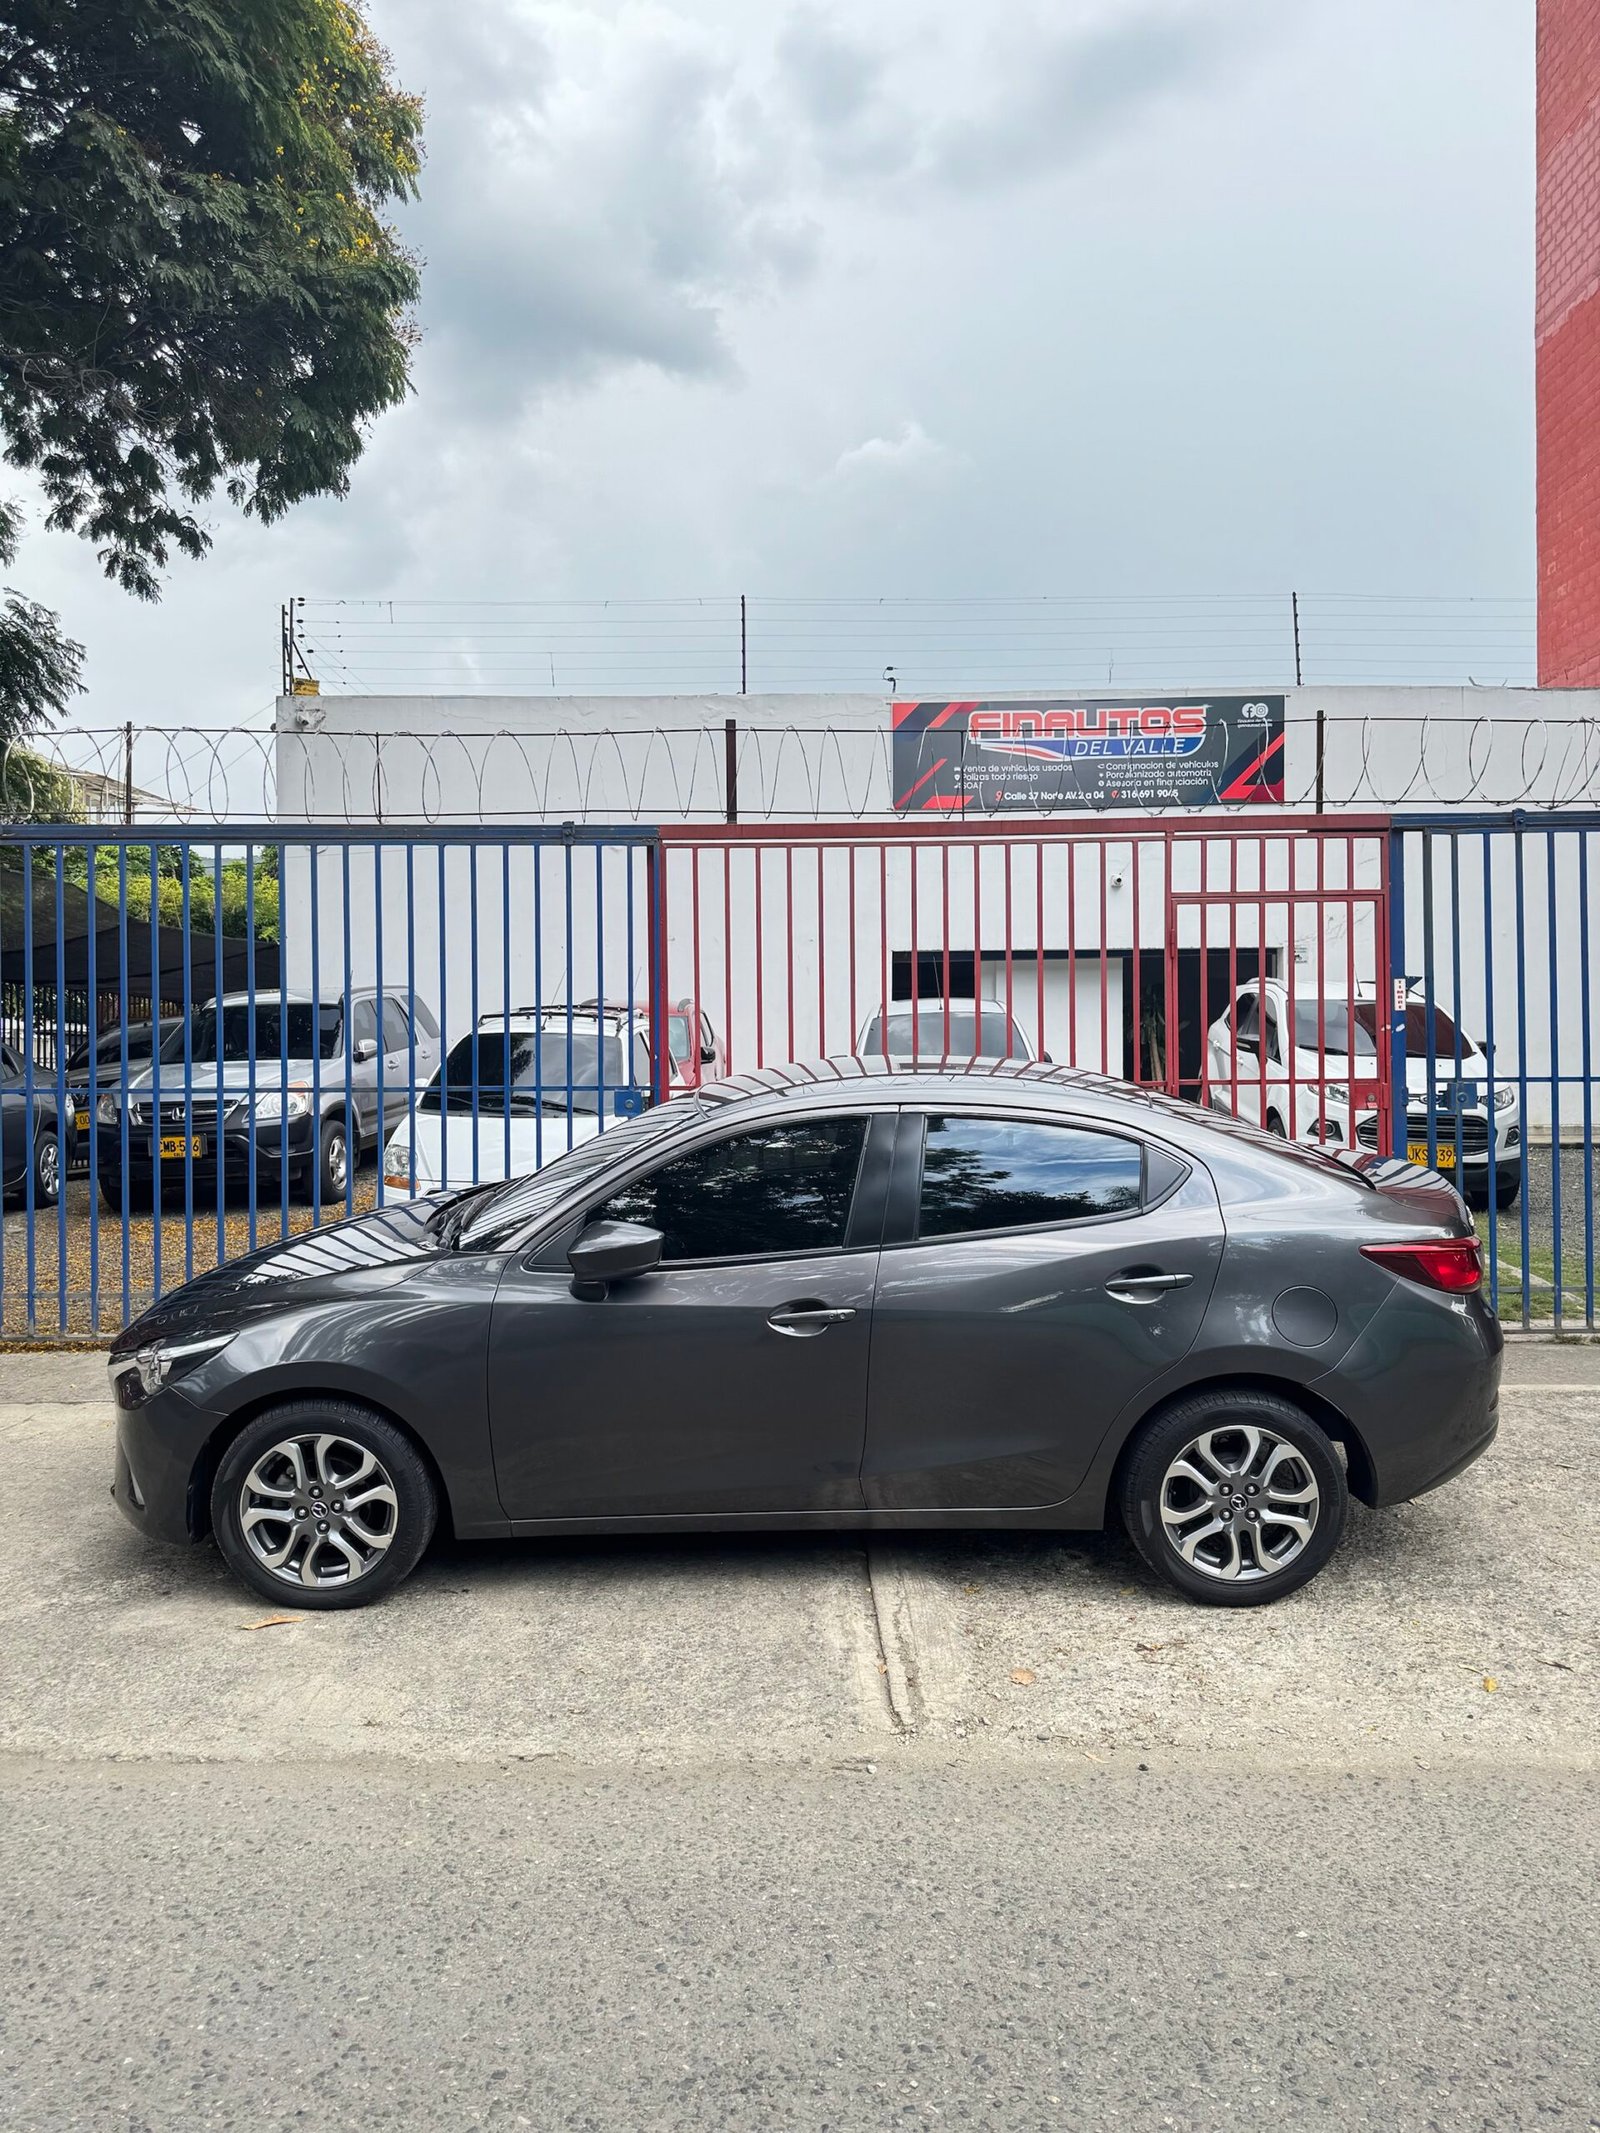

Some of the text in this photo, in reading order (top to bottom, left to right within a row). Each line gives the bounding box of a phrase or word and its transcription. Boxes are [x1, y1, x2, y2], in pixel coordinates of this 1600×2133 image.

[969, 707, 1207, 739] FINAUTOS
[1075, 738, 1187, 756] DEL VALLE
[988, 764, 1000, 772] de
[1042, 763, 1073, 772] usados
[1165, 761, 1177, 769] de
[991, 772, 1011, 781] todo
[1012, 772, 1039, 782] riesgo
[1167, 769, 1212, 778] automotriz
[1143, 779, 1155, 787] en
[1004, 791, 1027, 800] Calle
[1028, 791, 1039, 800] 37
[1093, 790, 1105, 799] 04
[1121, 790, 1138, 799] 316
[1139, 789, 1155, 798] 691
[1408, 1148, 1453, 1162] JKS39
